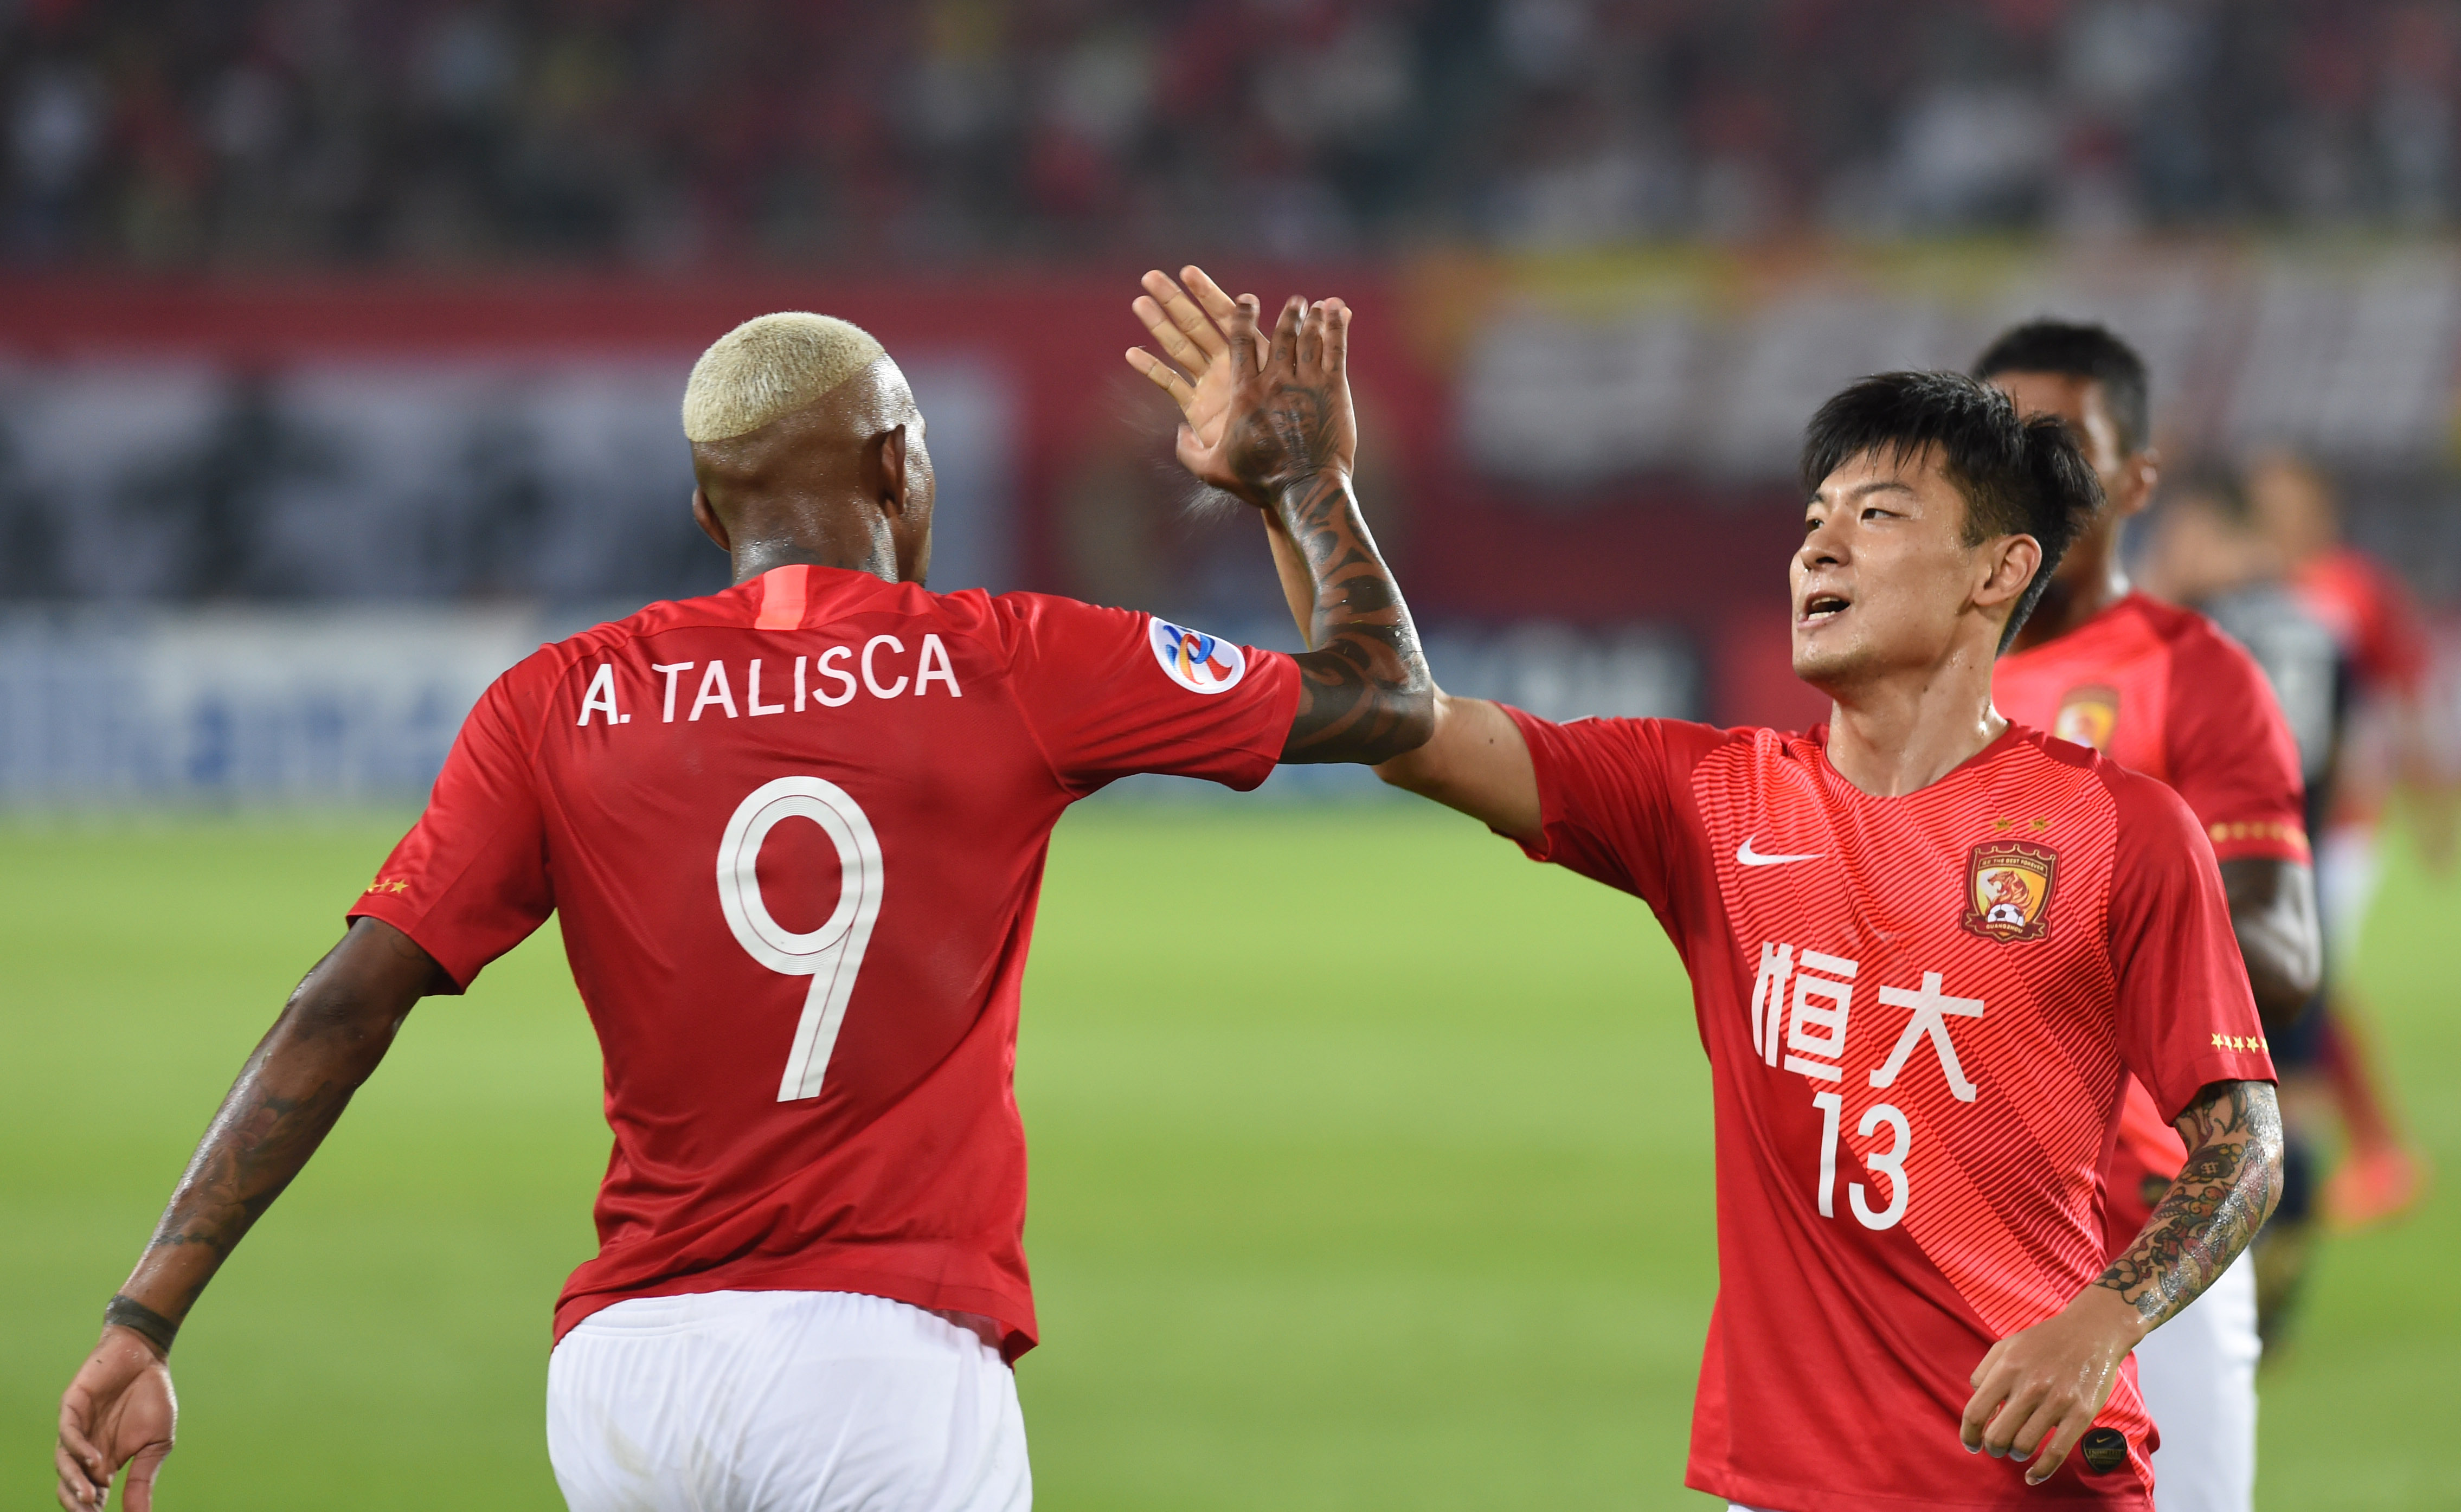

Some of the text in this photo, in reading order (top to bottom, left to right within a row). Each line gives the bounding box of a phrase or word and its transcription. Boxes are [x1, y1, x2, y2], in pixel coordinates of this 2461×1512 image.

[576, 663, 631, 726] A.
[652, 633, 962, 723] TALISCA
[2021, 859, 2044, 871] FOREVER
[716, 775, 884, 1103] 9
[1985, 923, 2023, 934] GUANGZHOU
[1751, 941, 1985, 1103] 恒大
[1812, 1091, 1912, 1231] 13
